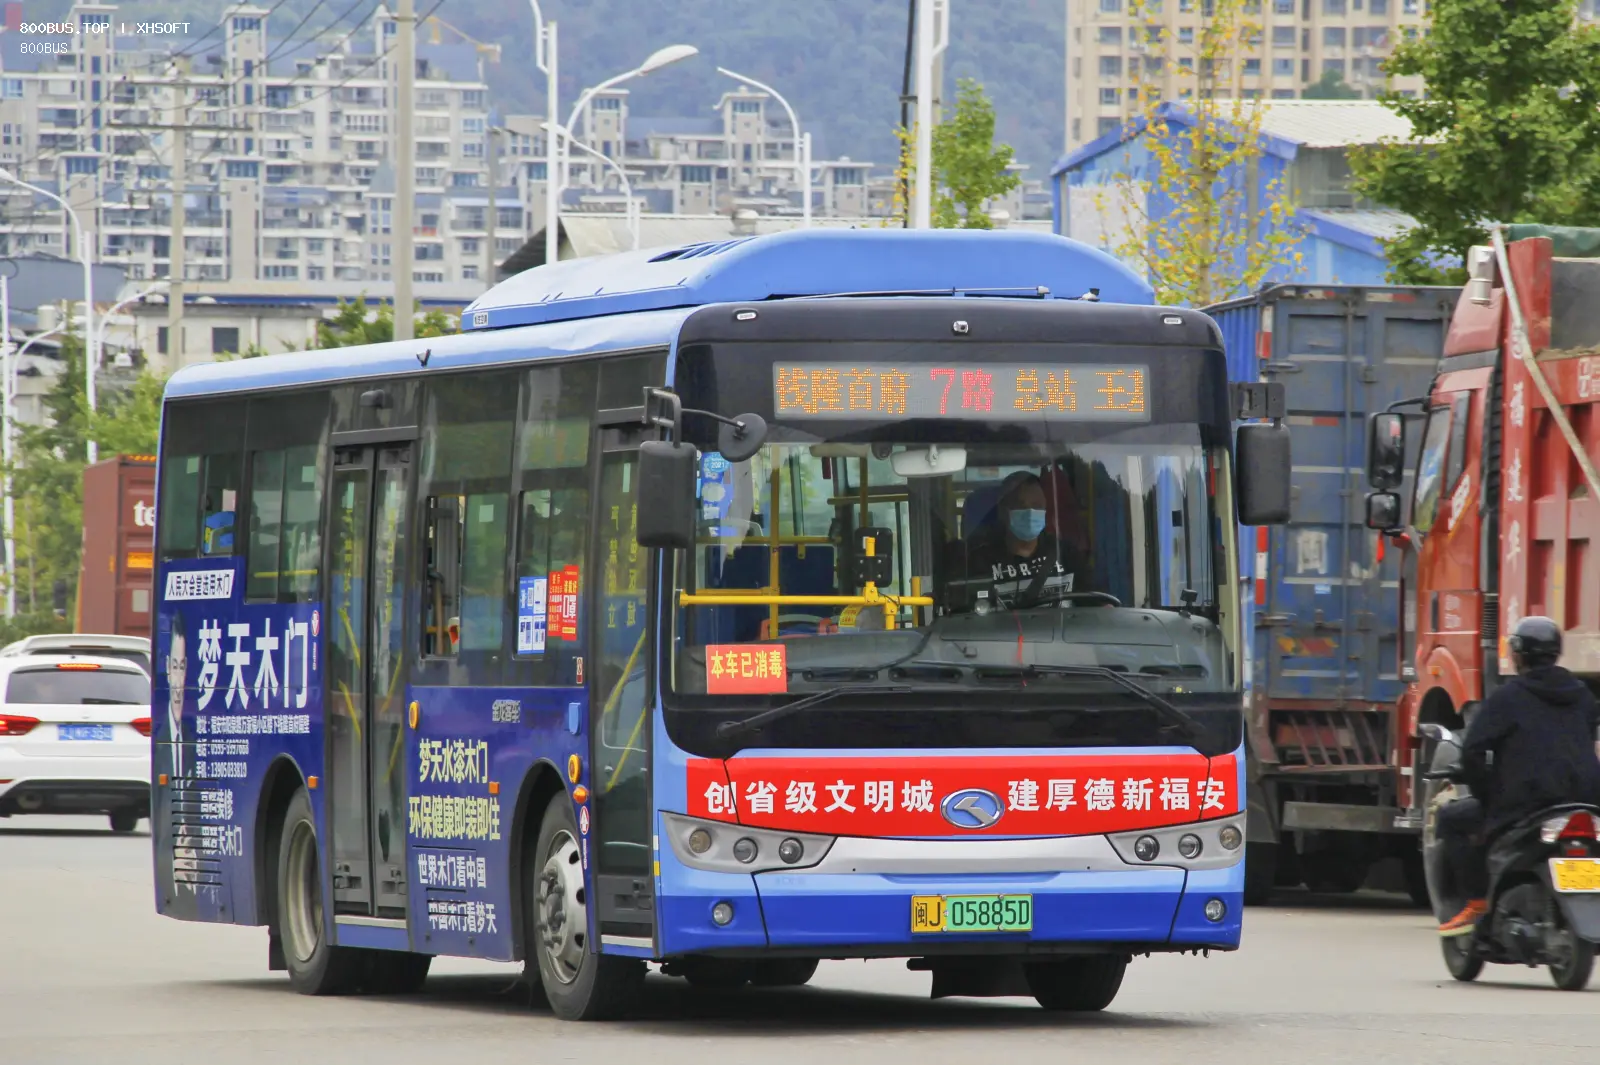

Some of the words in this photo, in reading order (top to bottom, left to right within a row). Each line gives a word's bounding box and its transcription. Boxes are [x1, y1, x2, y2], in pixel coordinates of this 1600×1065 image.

[1013, 368, 1077, 412] 总站
[168, 574, 230, 597] 人民大会堂选用木门
[197, 617, 309, 711] 梦天木门
[710, 650, 783, 679] 本车已消毒
[419, 739, 489, 784] 梦天水漆木门
[704, 779, 934, 815] 创省级文明城
[1007, 777, 1226, 812] 建厚德新福安
[408, 795, 501, 841] 环保健康即装即住
[418, 853, 487, 889] 世界木门看中国
[428, 900, 498, 934] 中国木门看梦天
